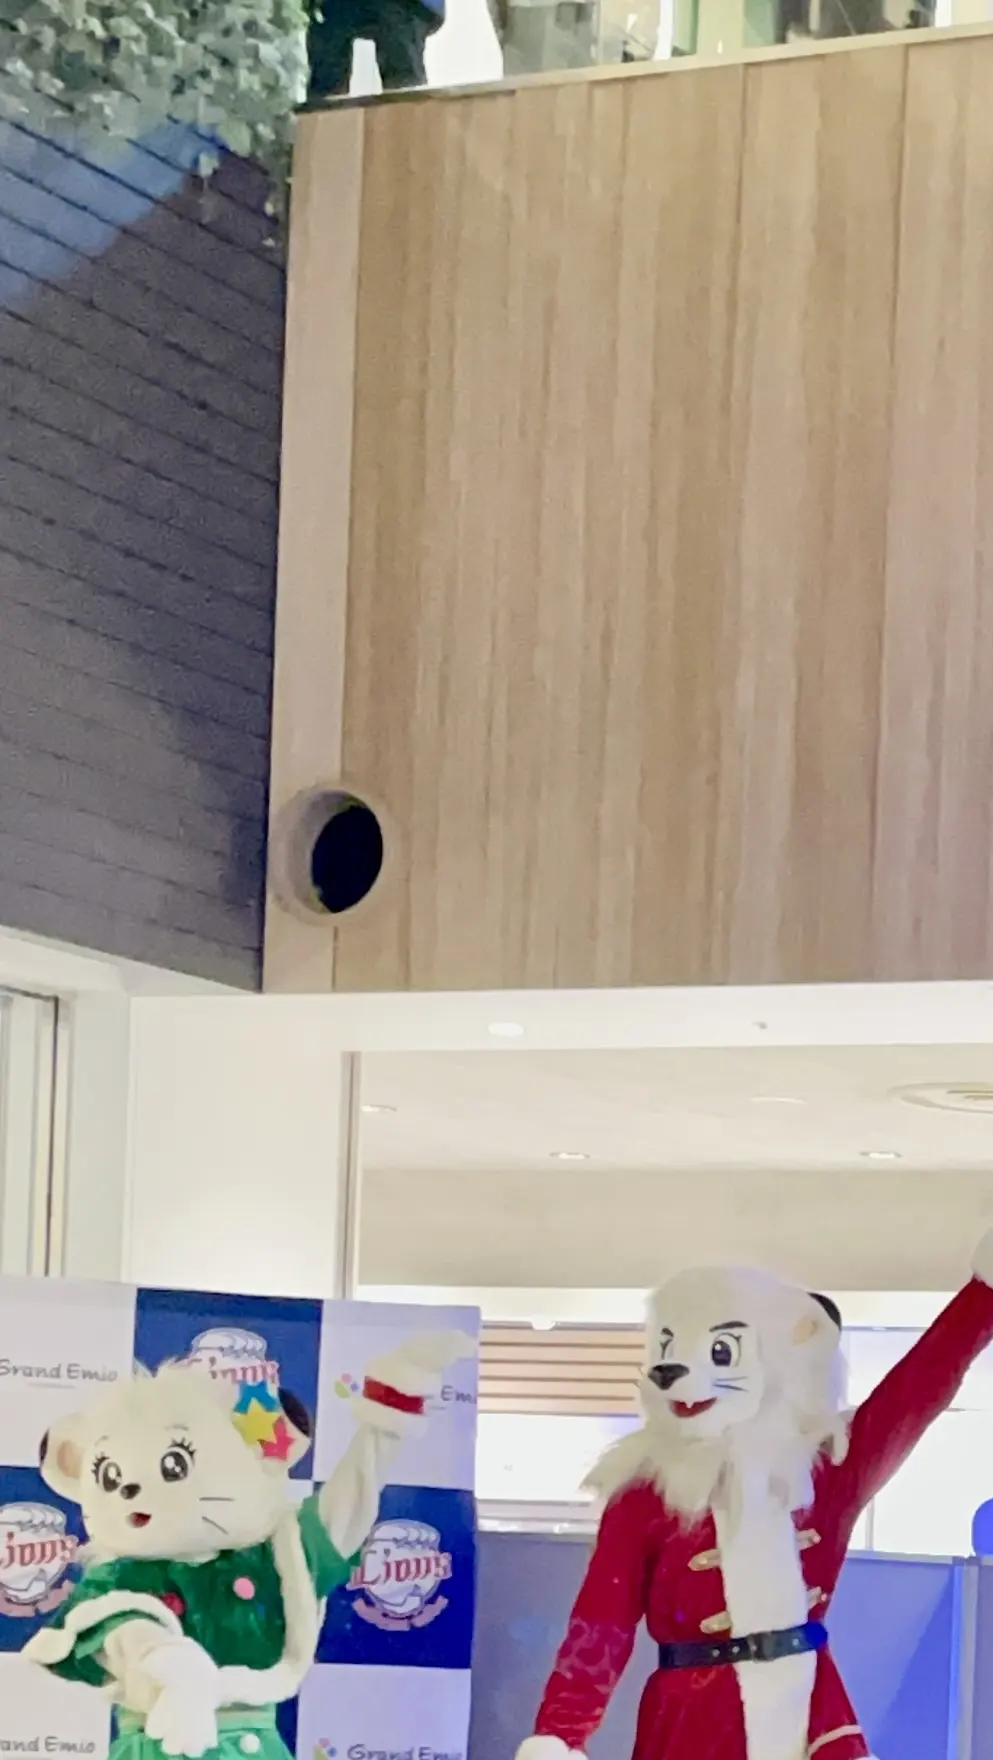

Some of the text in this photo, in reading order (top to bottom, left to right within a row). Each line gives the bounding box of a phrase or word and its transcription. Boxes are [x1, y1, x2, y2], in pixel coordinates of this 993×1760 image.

[66, 1362, 118, 1382] Emio
[0, 1531, 79, 1569] ions
[346, 1547, 452, 1590] Lions
[0, 1735, 96, 1754] and Emio
